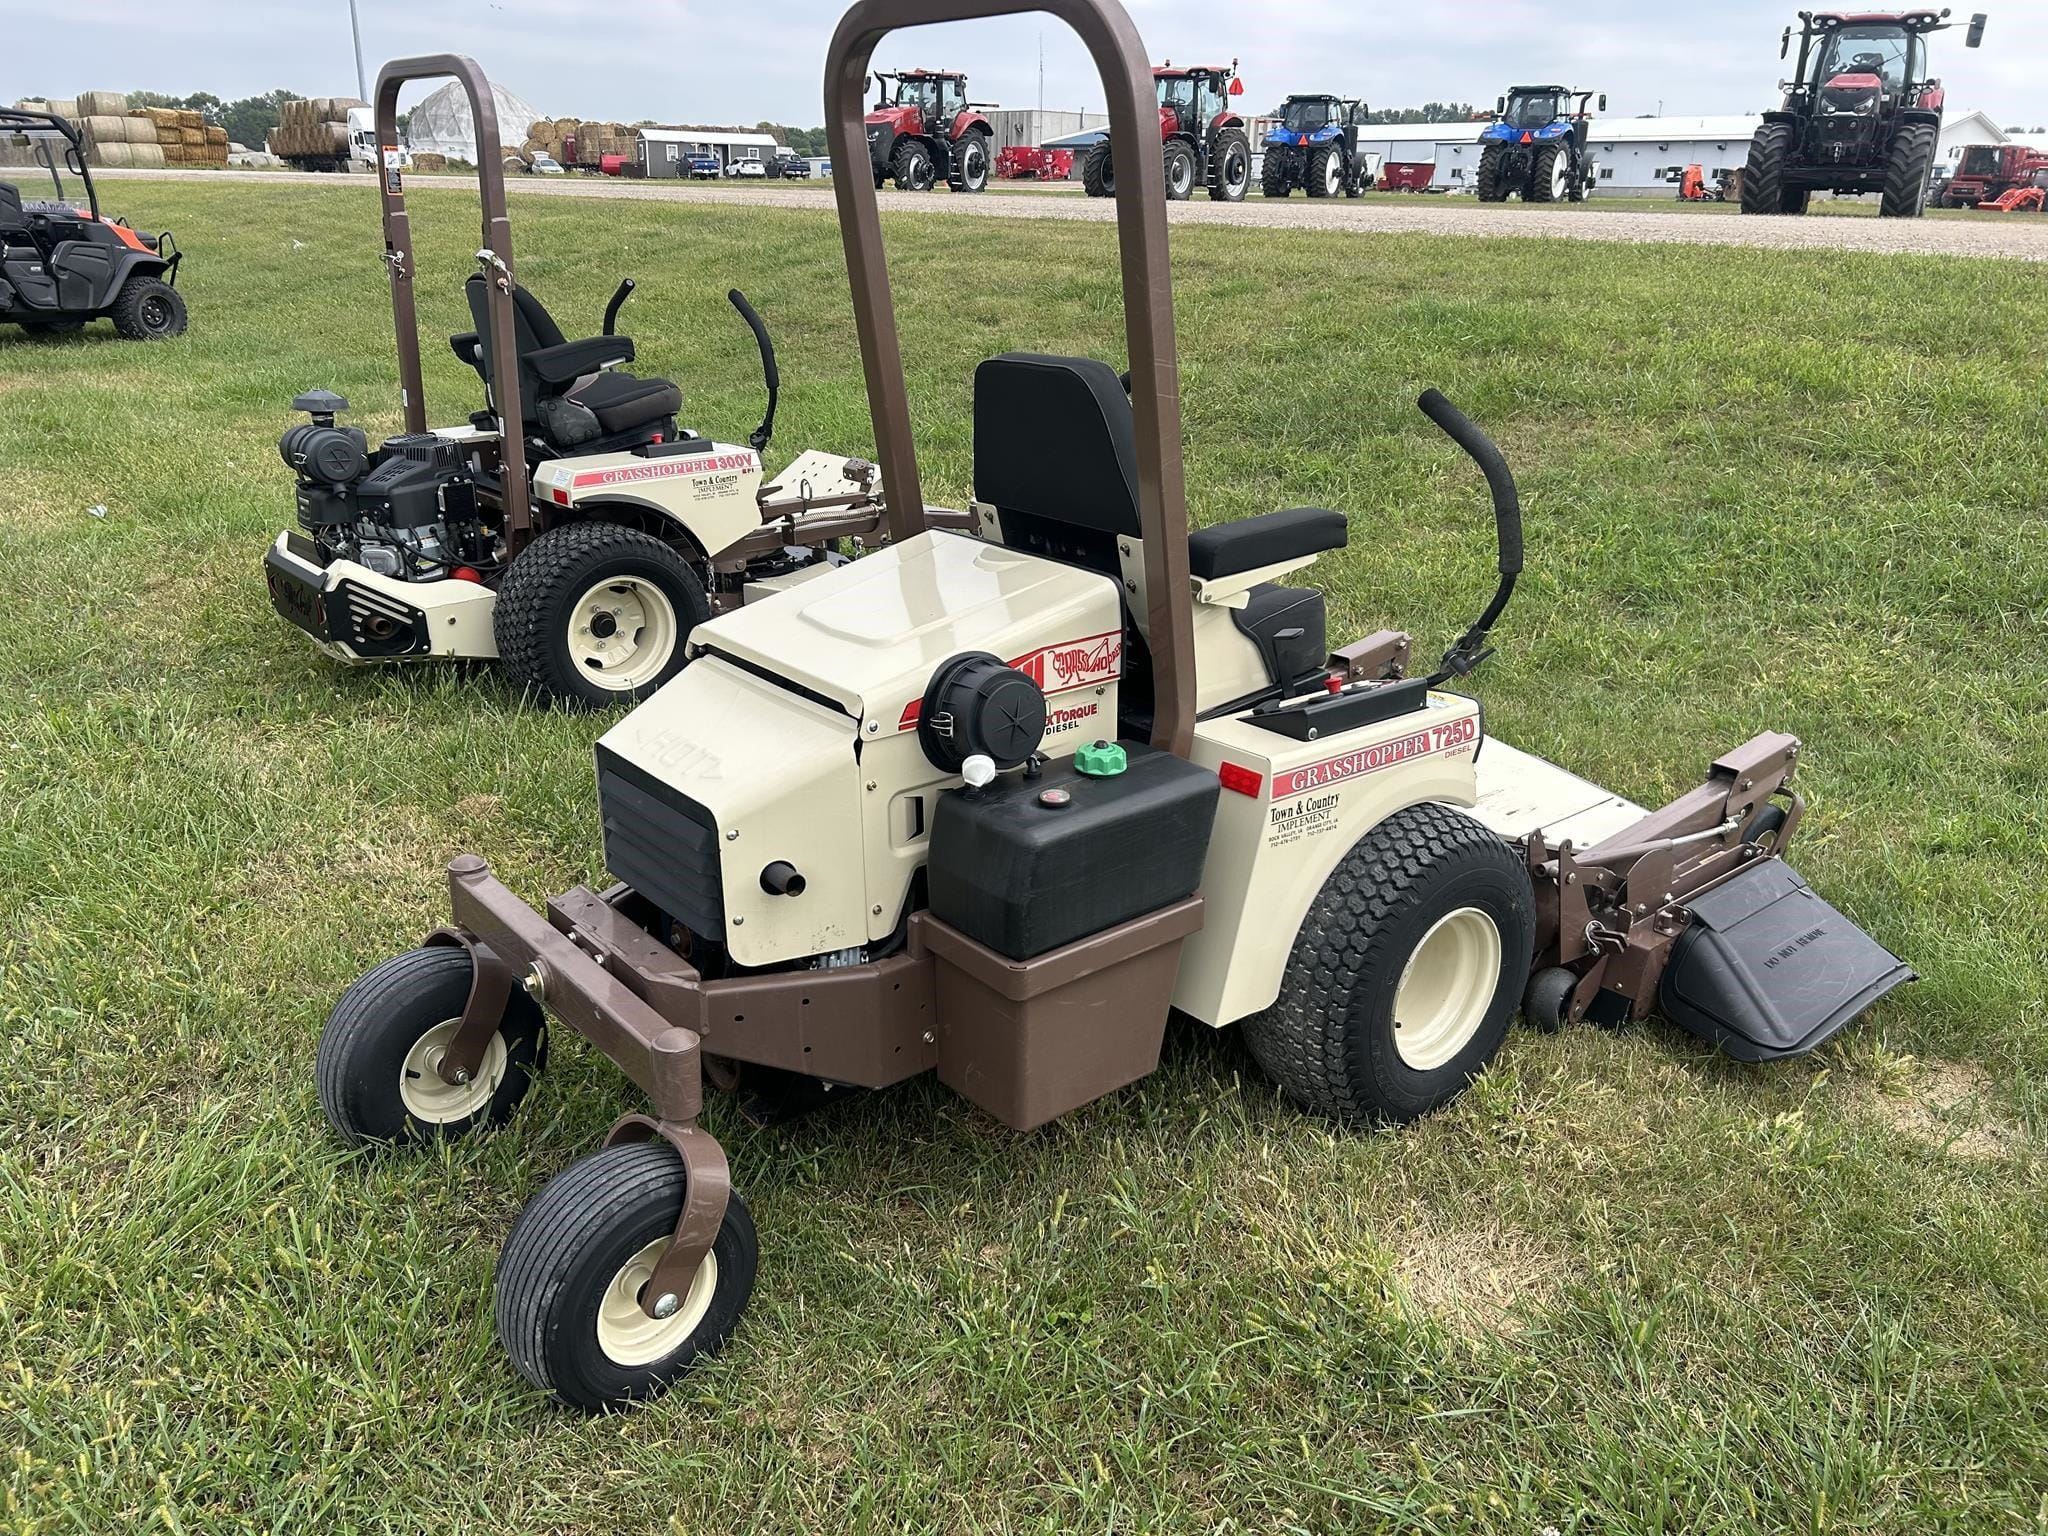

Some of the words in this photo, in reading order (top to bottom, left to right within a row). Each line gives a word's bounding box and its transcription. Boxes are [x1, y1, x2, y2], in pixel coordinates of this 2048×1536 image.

[602, 460, 709, 483] GRASSHOPPER
[718, 453, 752, 469] 300V
[1045, 721, 1080, 736] DIESEL
[1291, 734, 1425, 791] GRASSHOPPER
[1432, 718, 1475, 749] 725D
[1444, 744, 1472, 759] DIESEL
[1271, 807, 1293, 823] Town
[1296, 800, 1303, 815] &
[1306, 793, 1340, 812] Country
[1277, 810, 1331, 833] IMPLEMENT
[1763, 957, 1780, 969] DO
[1777, 945, 1798, 959] NOT
[1795, 928, 1828, 947] REMOVE
